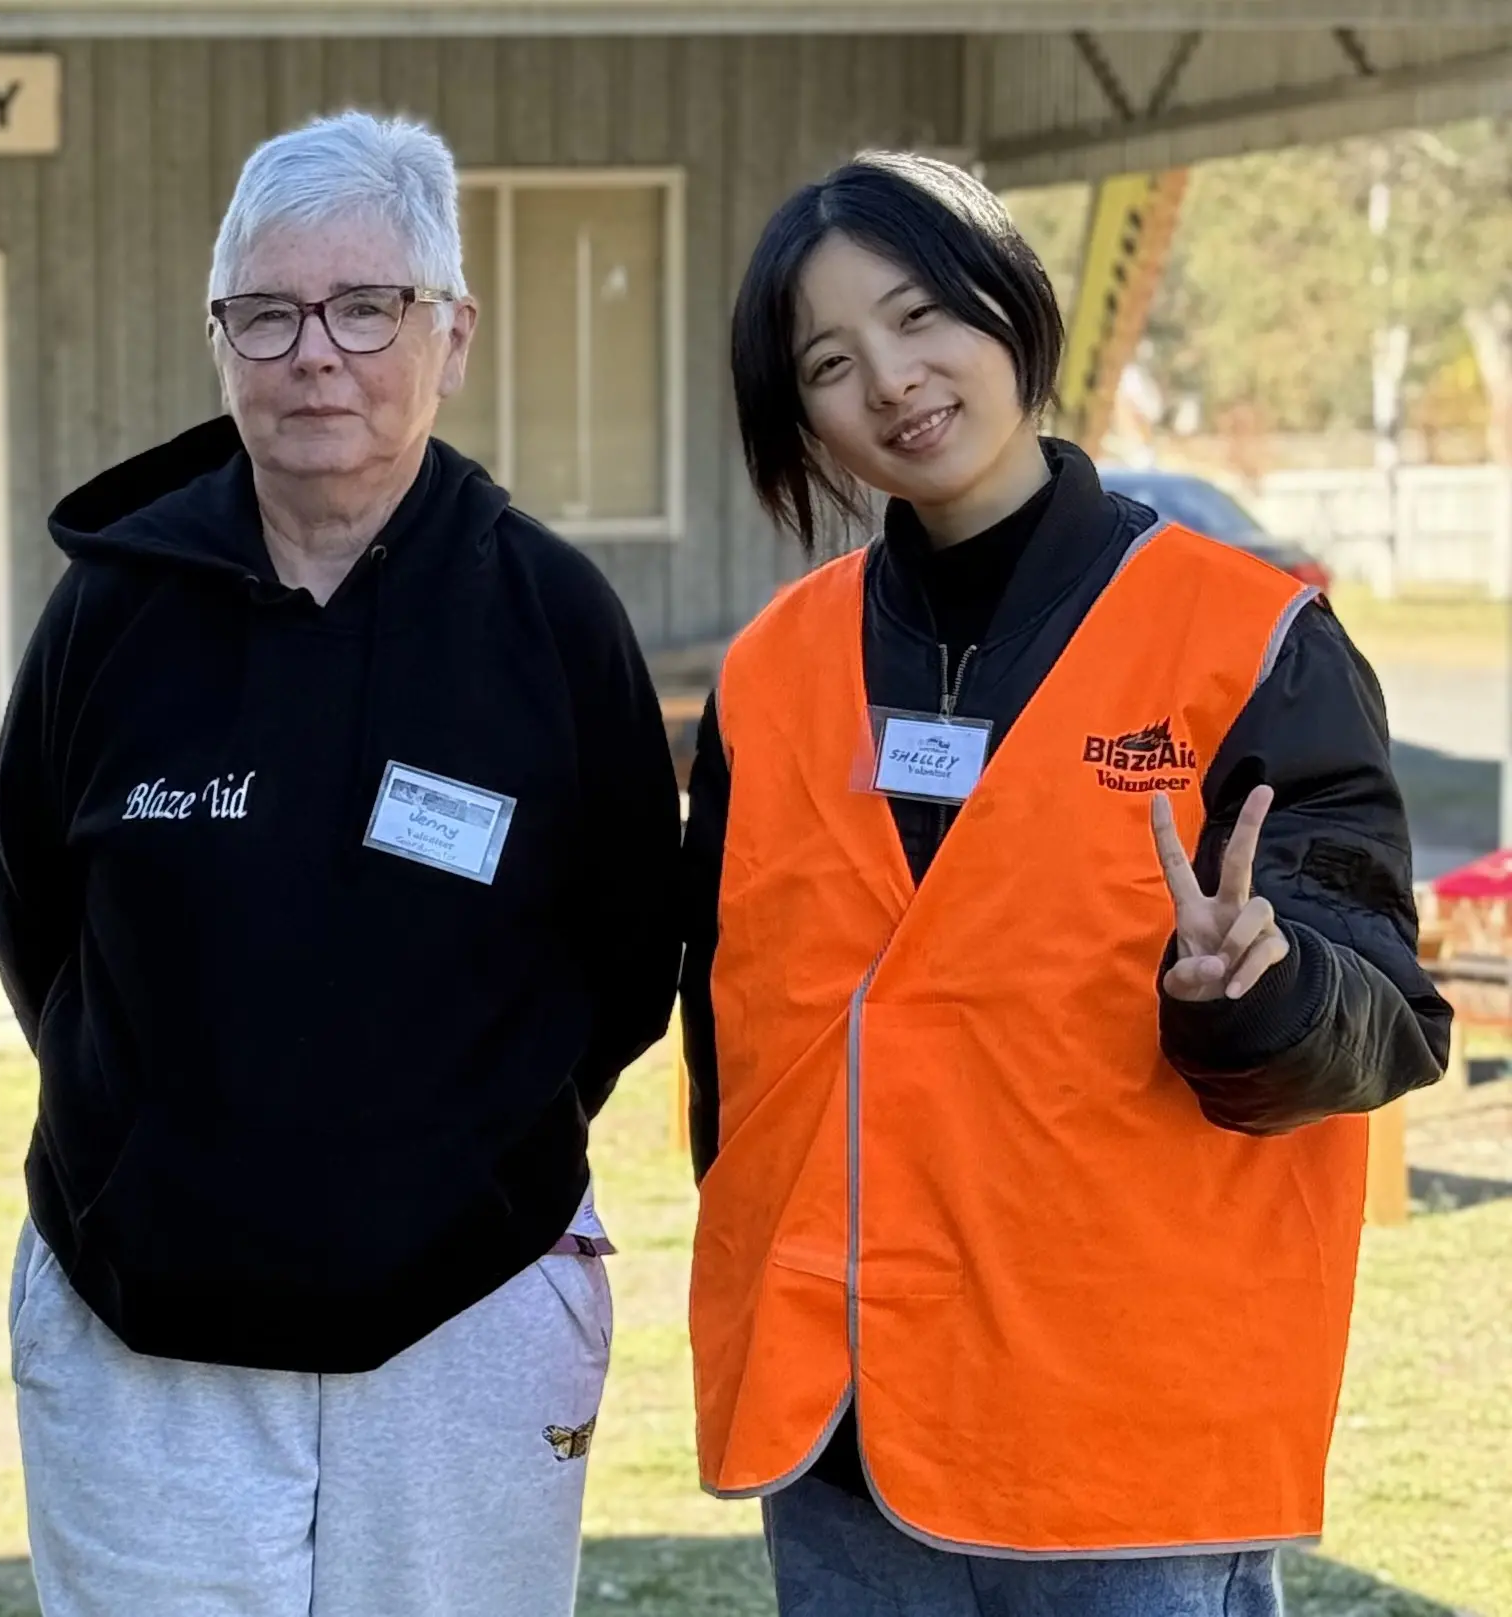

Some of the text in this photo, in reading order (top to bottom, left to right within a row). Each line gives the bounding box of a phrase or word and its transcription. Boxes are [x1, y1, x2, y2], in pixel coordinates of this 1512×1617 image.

[889, 749, 960, 770] SHELLEY
[1096, 769, 1190, 792] Volunteer
[122, 777, 196, 819] Blaze
[409, 810, 459, 840] Jenny
